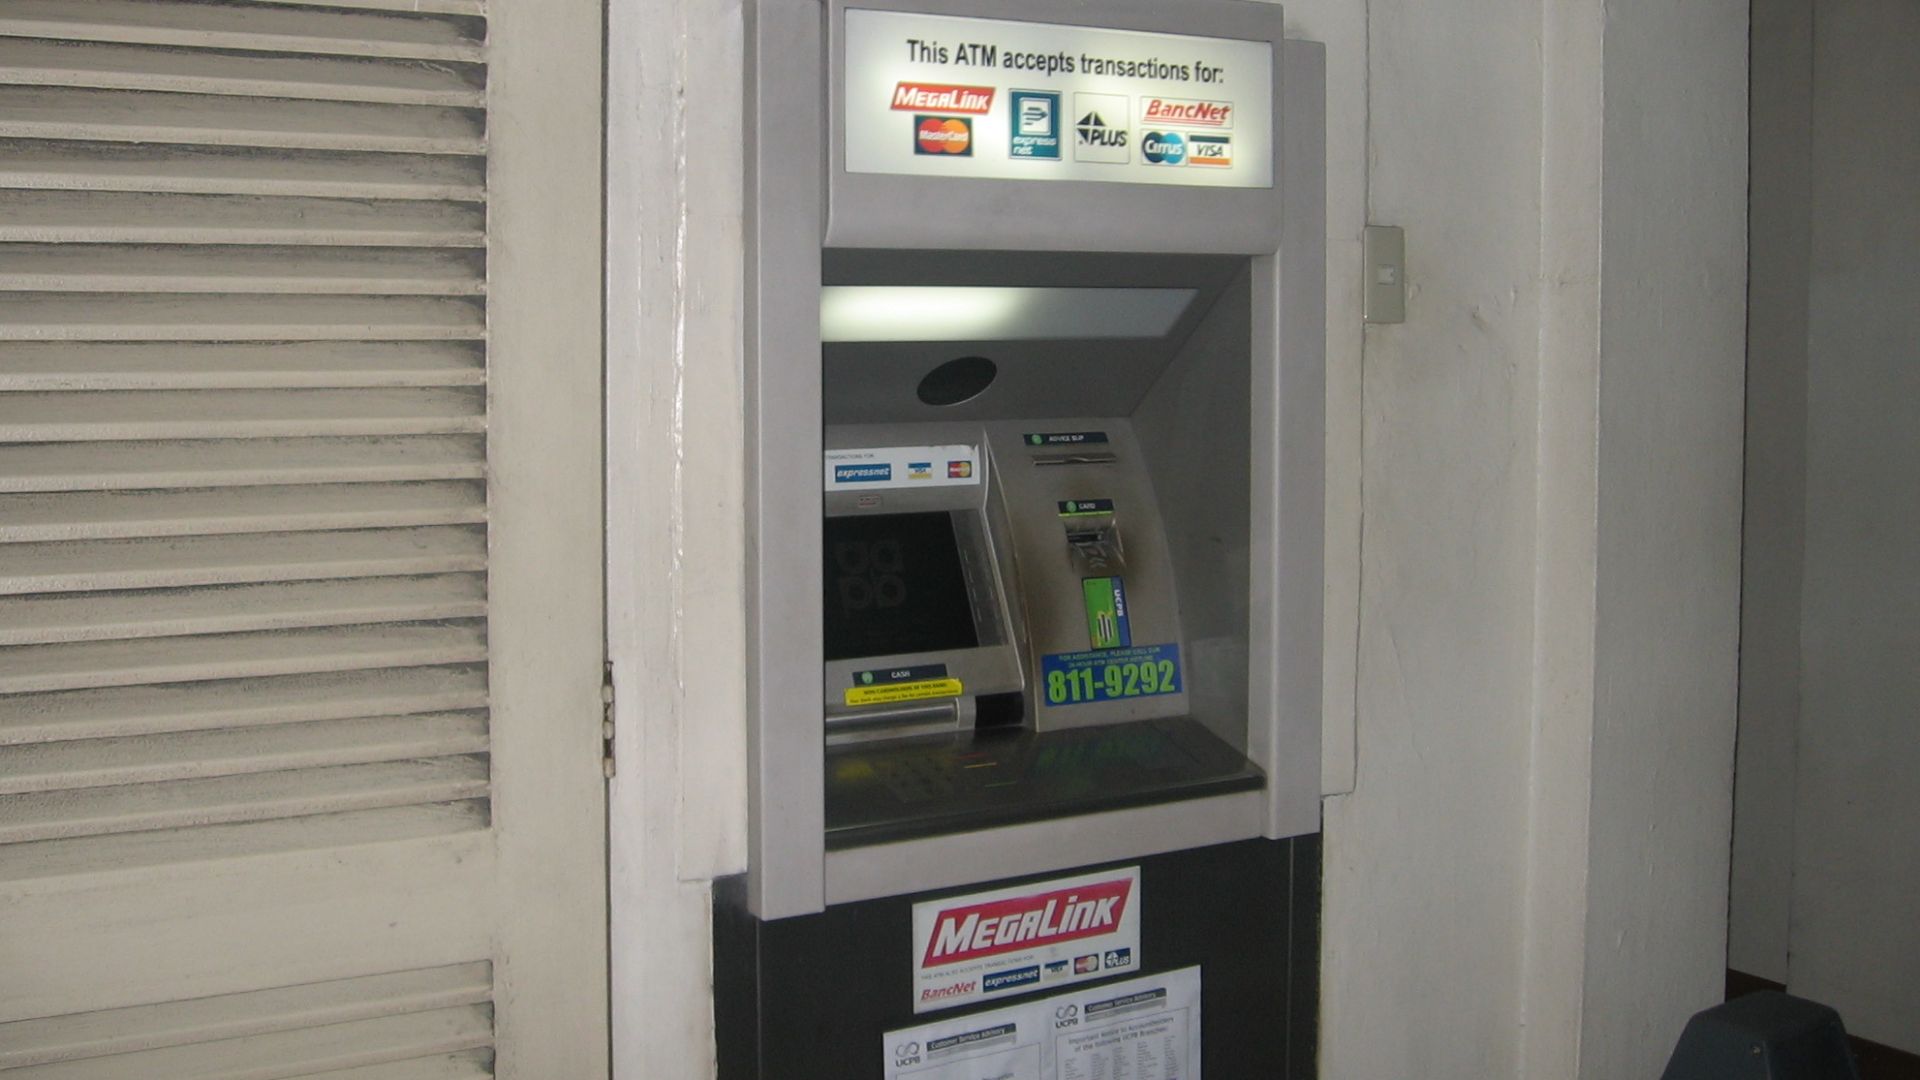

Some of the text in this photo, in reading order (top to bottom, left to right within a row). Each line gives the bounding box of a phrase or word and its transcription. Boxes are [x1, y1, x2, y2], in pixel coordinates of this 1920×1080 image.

[907, 39, 1224, 83] This ATM accepts transactions for:
[1146, 99, 1232, 120] BancNet
[1090, 129, 1128, 147] PLUS
[1144, 140, 1183, 155] Cirrus
[1197, 144, 1223, 157] VISA
[1114, 589, 1124, 617] UCPB
[891, 671, 911, 679] CASH
[1048, 659, 1175, 703] 811-9292
[985, 969, 1039, 988] expressnet
[920, 981, 977, 1000] BancNet
[1055, 1018, 1078, 1029] UCPB
[896, 1056, 920, 1068] UCPB
